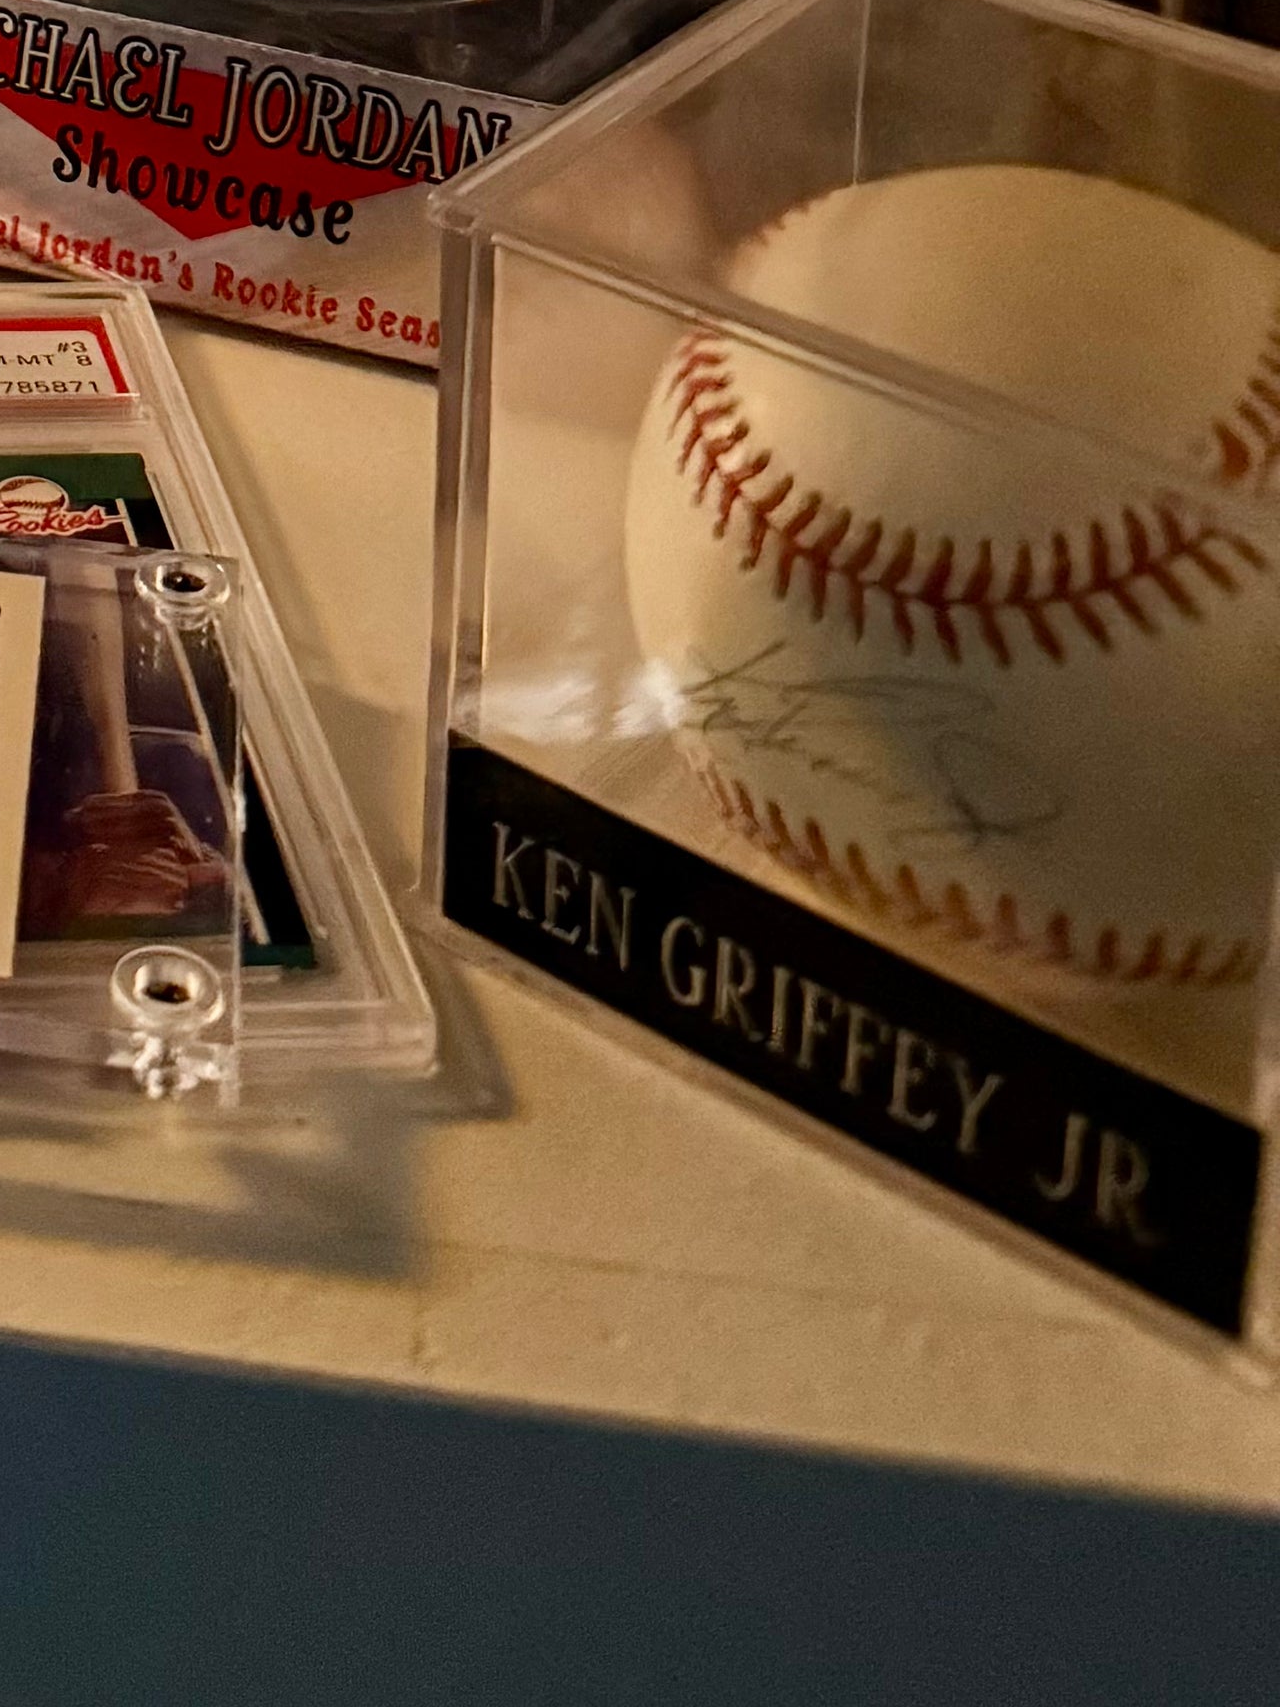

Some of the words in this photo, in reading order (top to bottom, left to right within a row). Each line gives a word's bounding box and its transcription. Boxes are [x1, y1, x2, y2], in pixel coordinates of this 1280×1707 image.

[205, 56, 509, 186] JORDAN
[52, 123, 354, 245] Showcase
[35, 221, 195, 292] Jordan's
[211, 261, 339, 326] Rookie
[57, 340, 88, 353] #3
[76, 354, 93, 367] 8
[491, 819, 637, 971] KEN
[659, 911, 1005, 1156] GRIFFEY
[1034, 1113, 1164, 1247] JR
